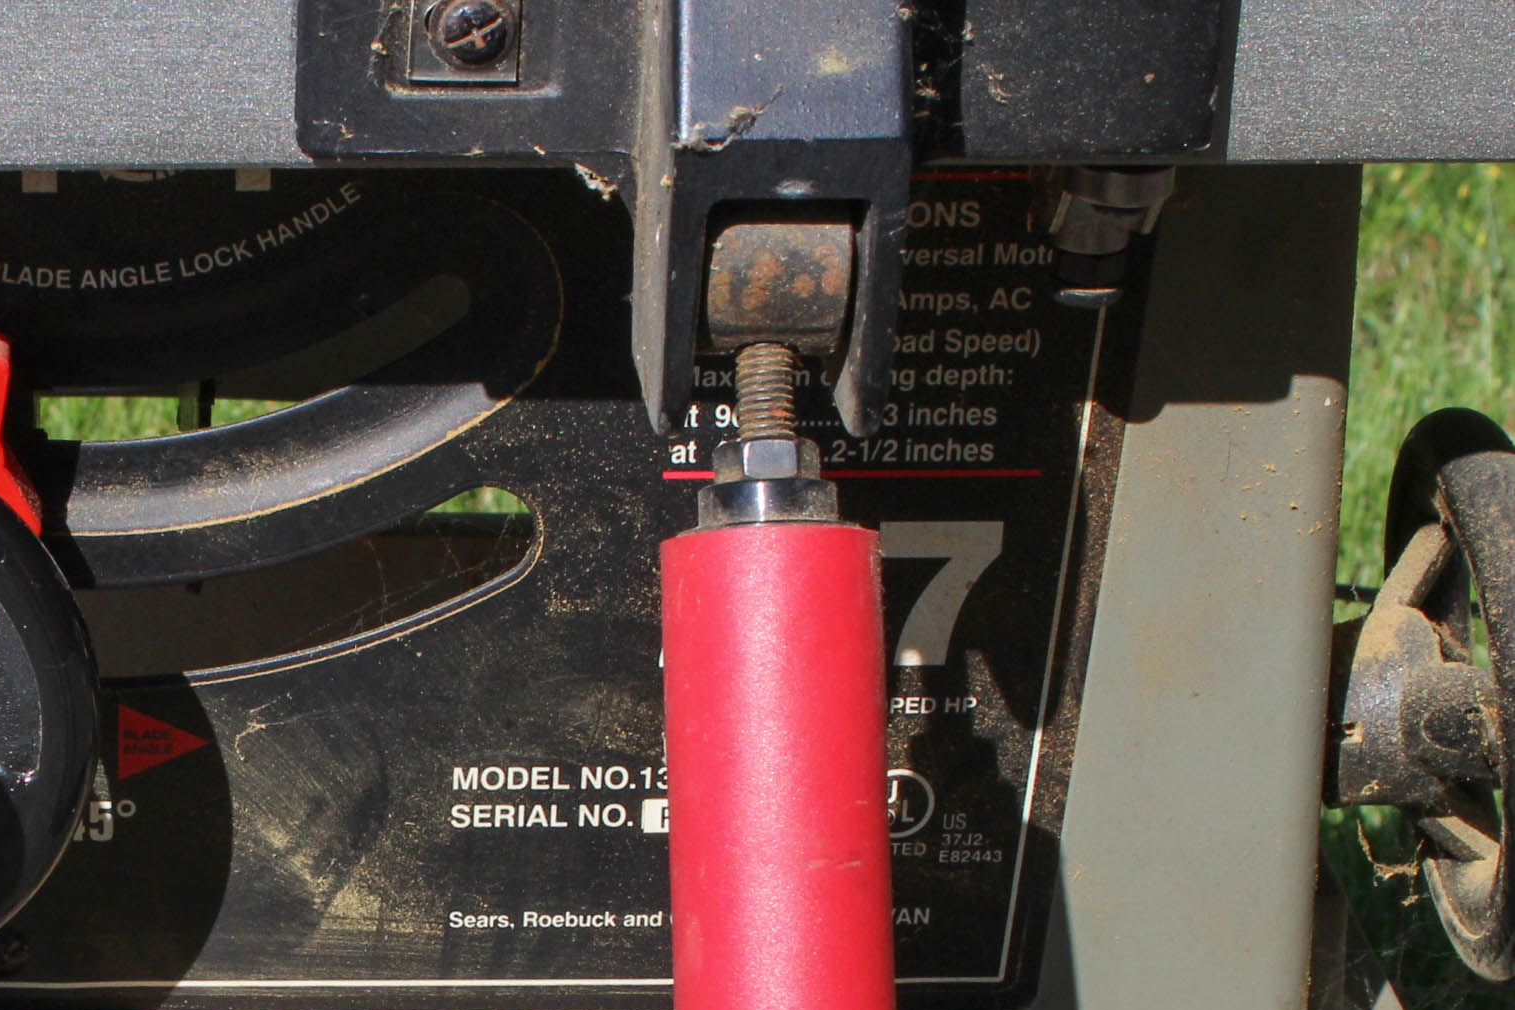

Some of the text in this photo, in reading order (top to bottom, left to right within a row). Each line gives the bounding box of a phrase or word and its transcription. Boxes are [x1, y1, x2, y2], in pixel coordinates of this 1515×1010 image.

[79, 261, 173, 290] ANGLE
[179, 239, 253, 279] LOCK
[258, 181, 363, 250] HANDLE
[989, 288, 1033, 310] AC
[891, 330, 1041, 358] oad Speed)
[925, 365, 1014, 391] depth:
[907, 402, 998, 426] inches
[905, 440, 995, 463] inches
[944, 696, 979, 714] HP
[452, 765, 571, 791] MODEL
[450, 803, 568, 829] SERIAL
[578, 803, 634, 829] NO.
[942, 812, 967, 831] US
[448, 910, 664, 931] Sears, Roebuck and
